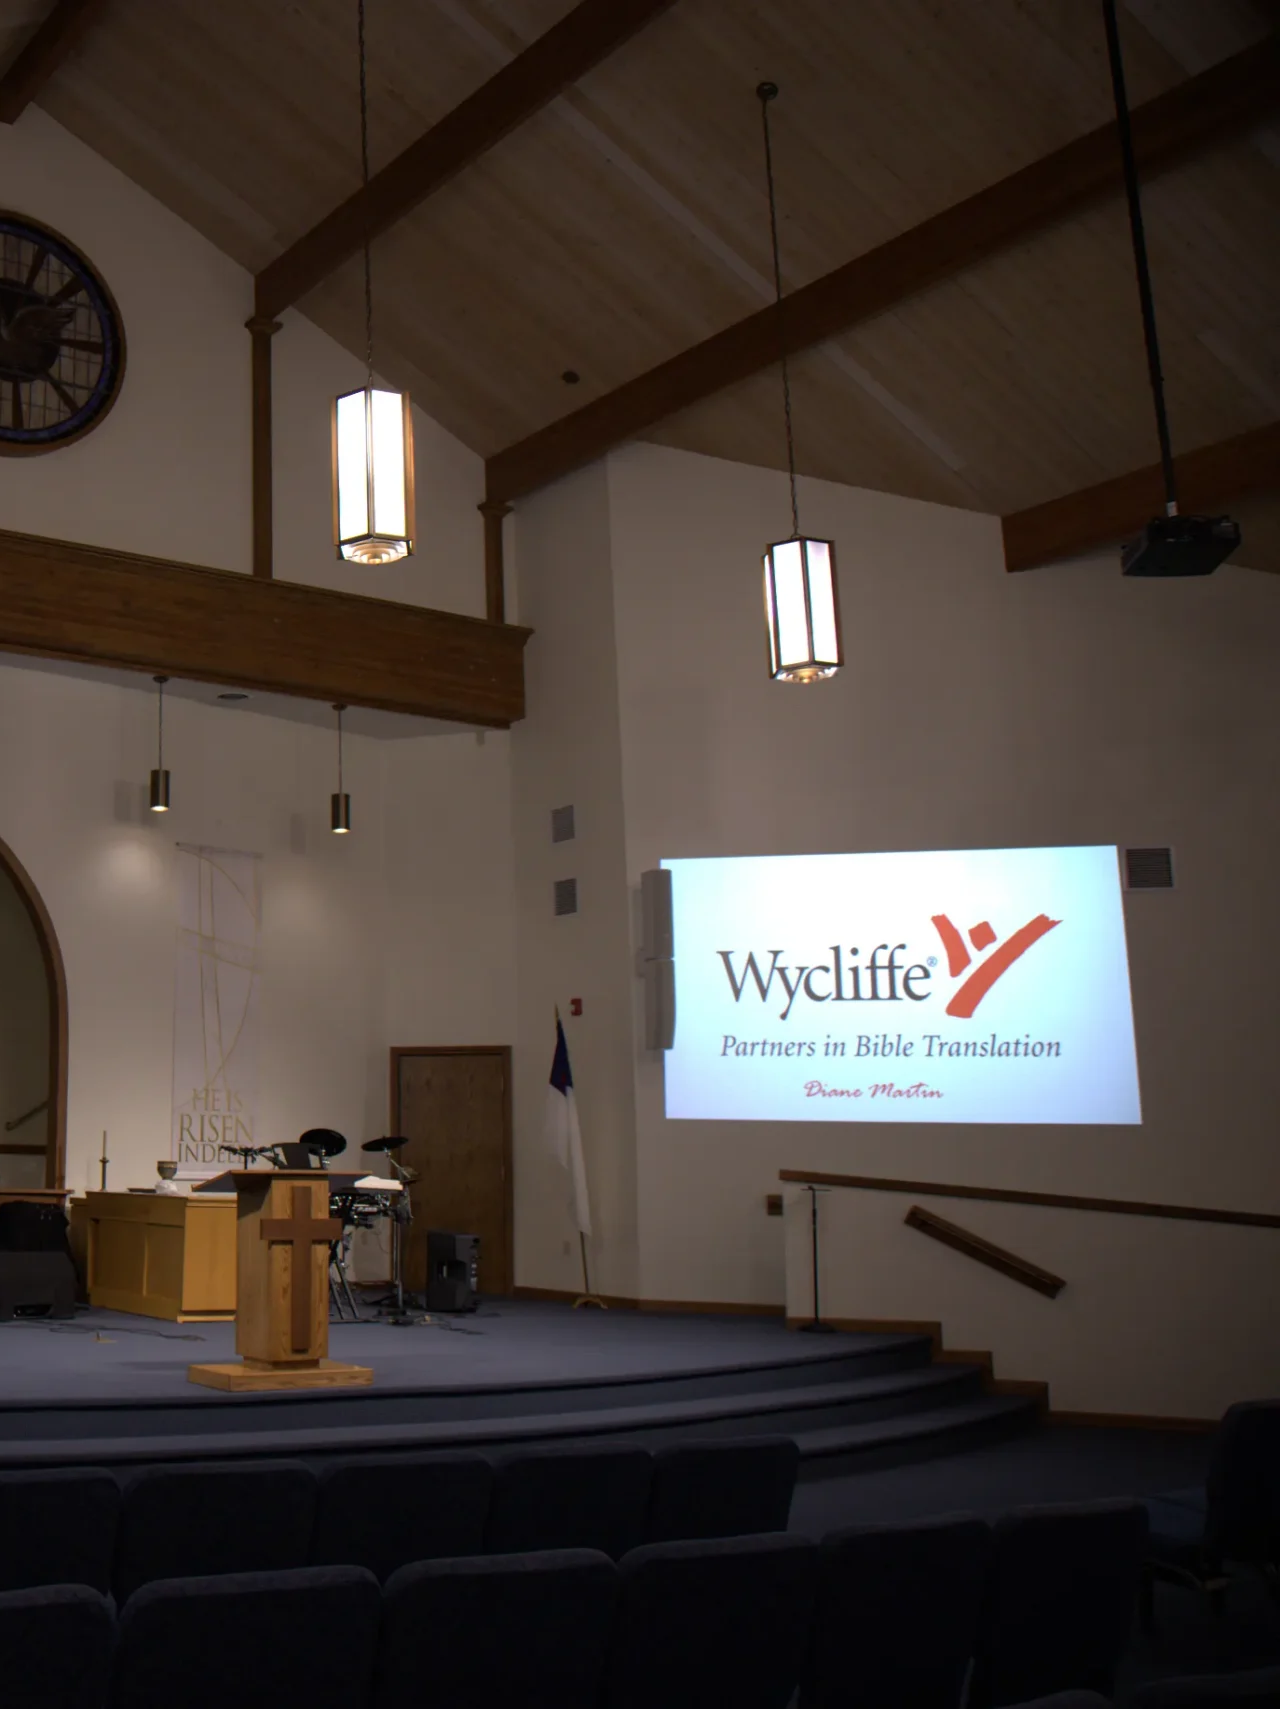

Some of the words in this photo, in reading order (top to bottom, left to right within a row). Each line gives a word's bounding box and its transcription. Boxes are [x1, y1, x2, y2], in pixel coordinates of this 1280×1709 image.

[716, 943, 933, 1021] Wycliffe
[720, 1034, 817, 1058] Partners
[823, 1034, 847, 1058] in
[854, 1033, 915, 1058] Bible
[923, 1033, 1063, 1059] Translation
[191, 1087, 222, 1112] HE
[224, 1087, 245, 1113] IS
[803, 1080, 864, 1099] Diane
[869, 1082, 945, 1099] Martin
[178, 1113, 254, 1143] RISEN
[177, 1143, 250, 1164] INDEE
